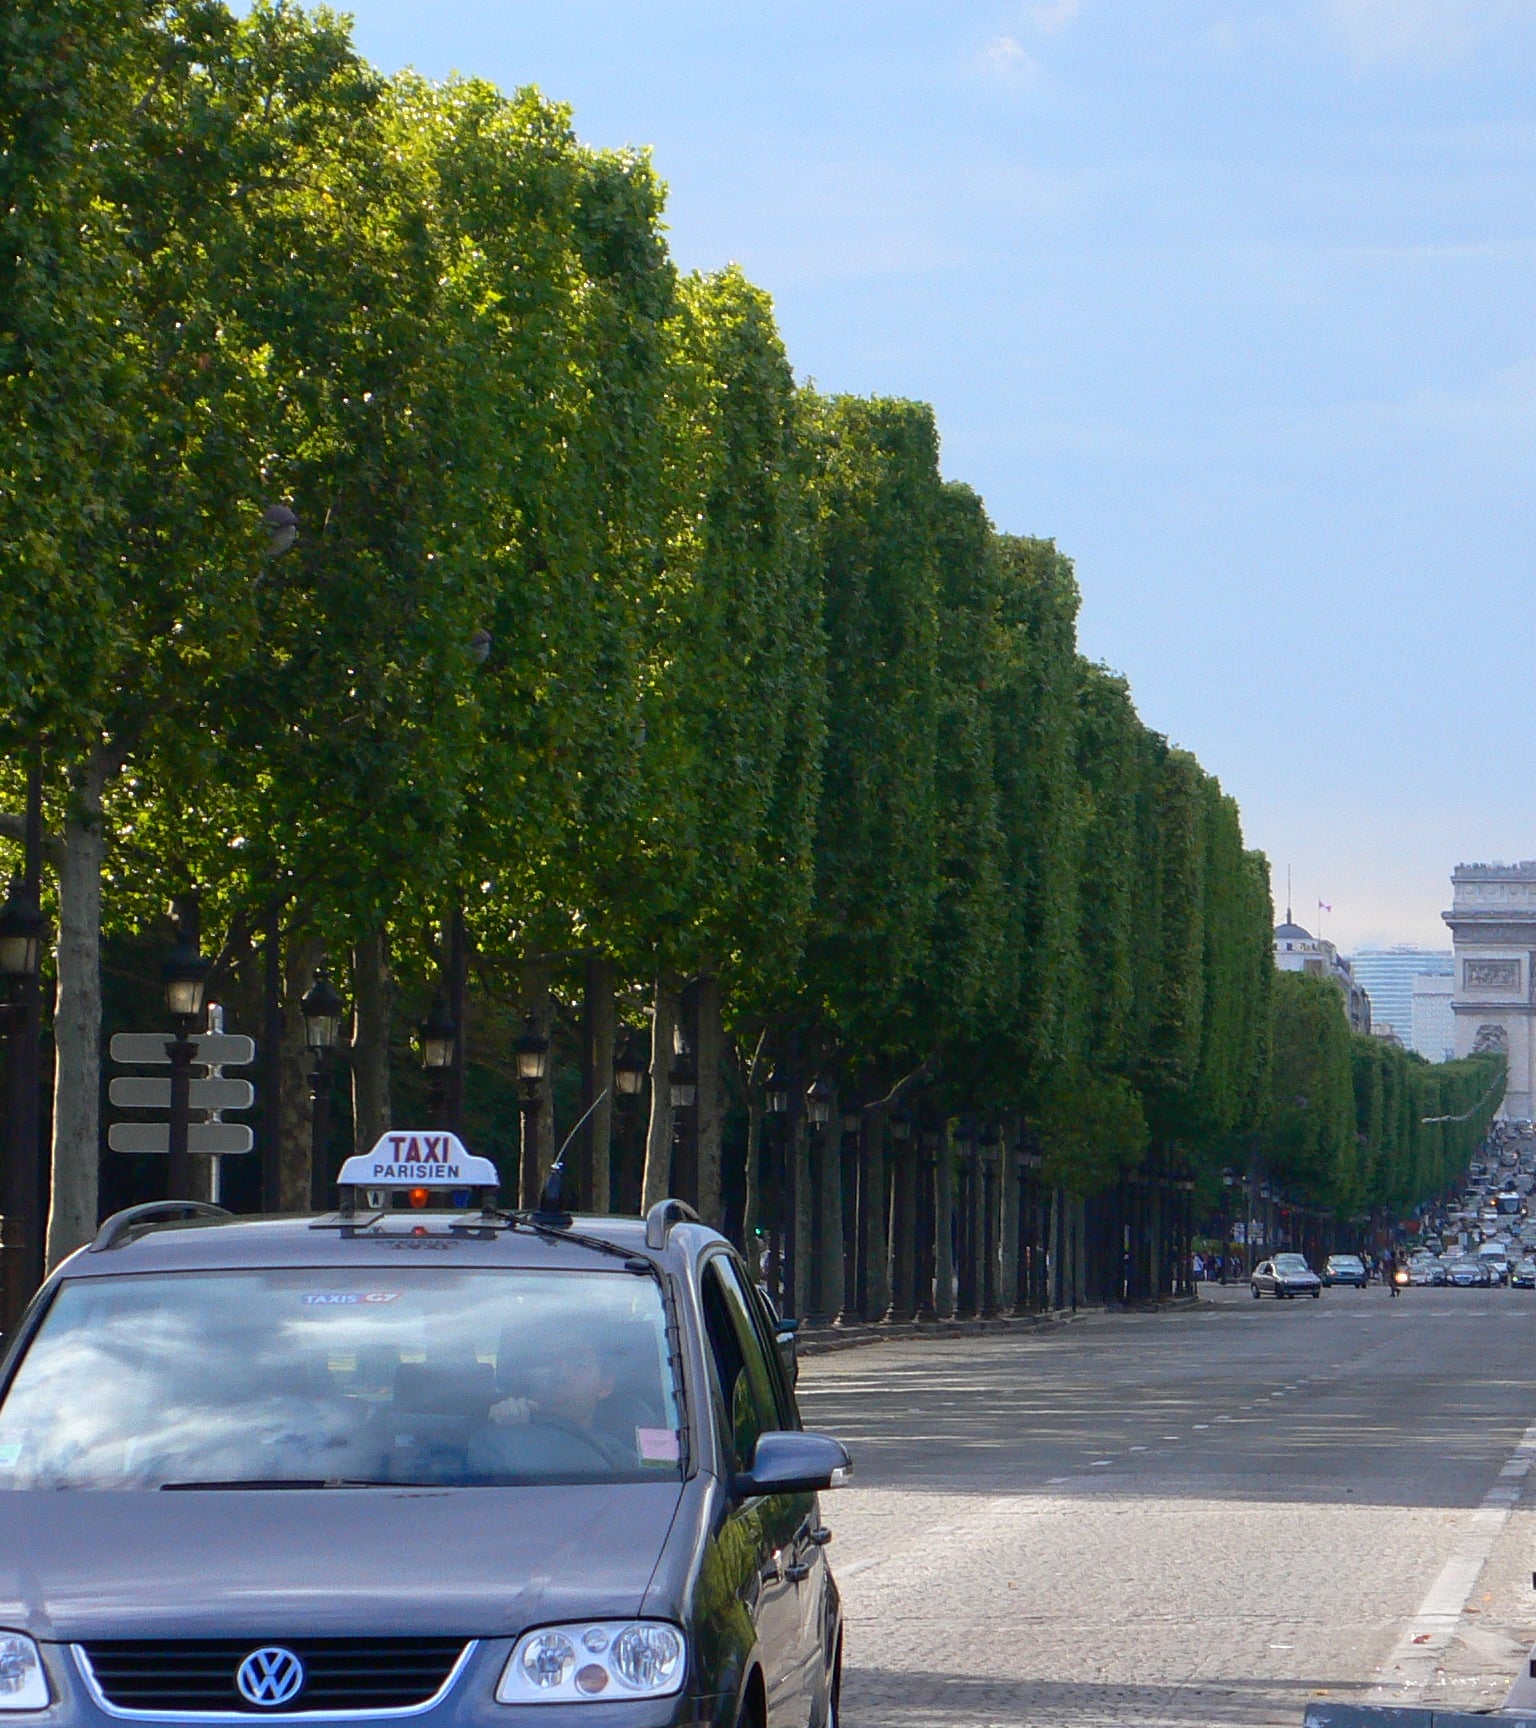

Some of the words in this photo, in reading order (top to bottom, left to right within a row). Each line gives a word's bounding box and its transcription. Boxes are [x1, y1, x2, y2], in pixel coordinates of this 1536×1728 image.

[389, 1136, 450, 1163] TAXI
[373, 1164, 460, 1178] PARISIEN
[307, 1294, 357, 1304] TAXIS
[366, 1293, 398, 1302] G7
[237, 1647, 303, 1706] VW
